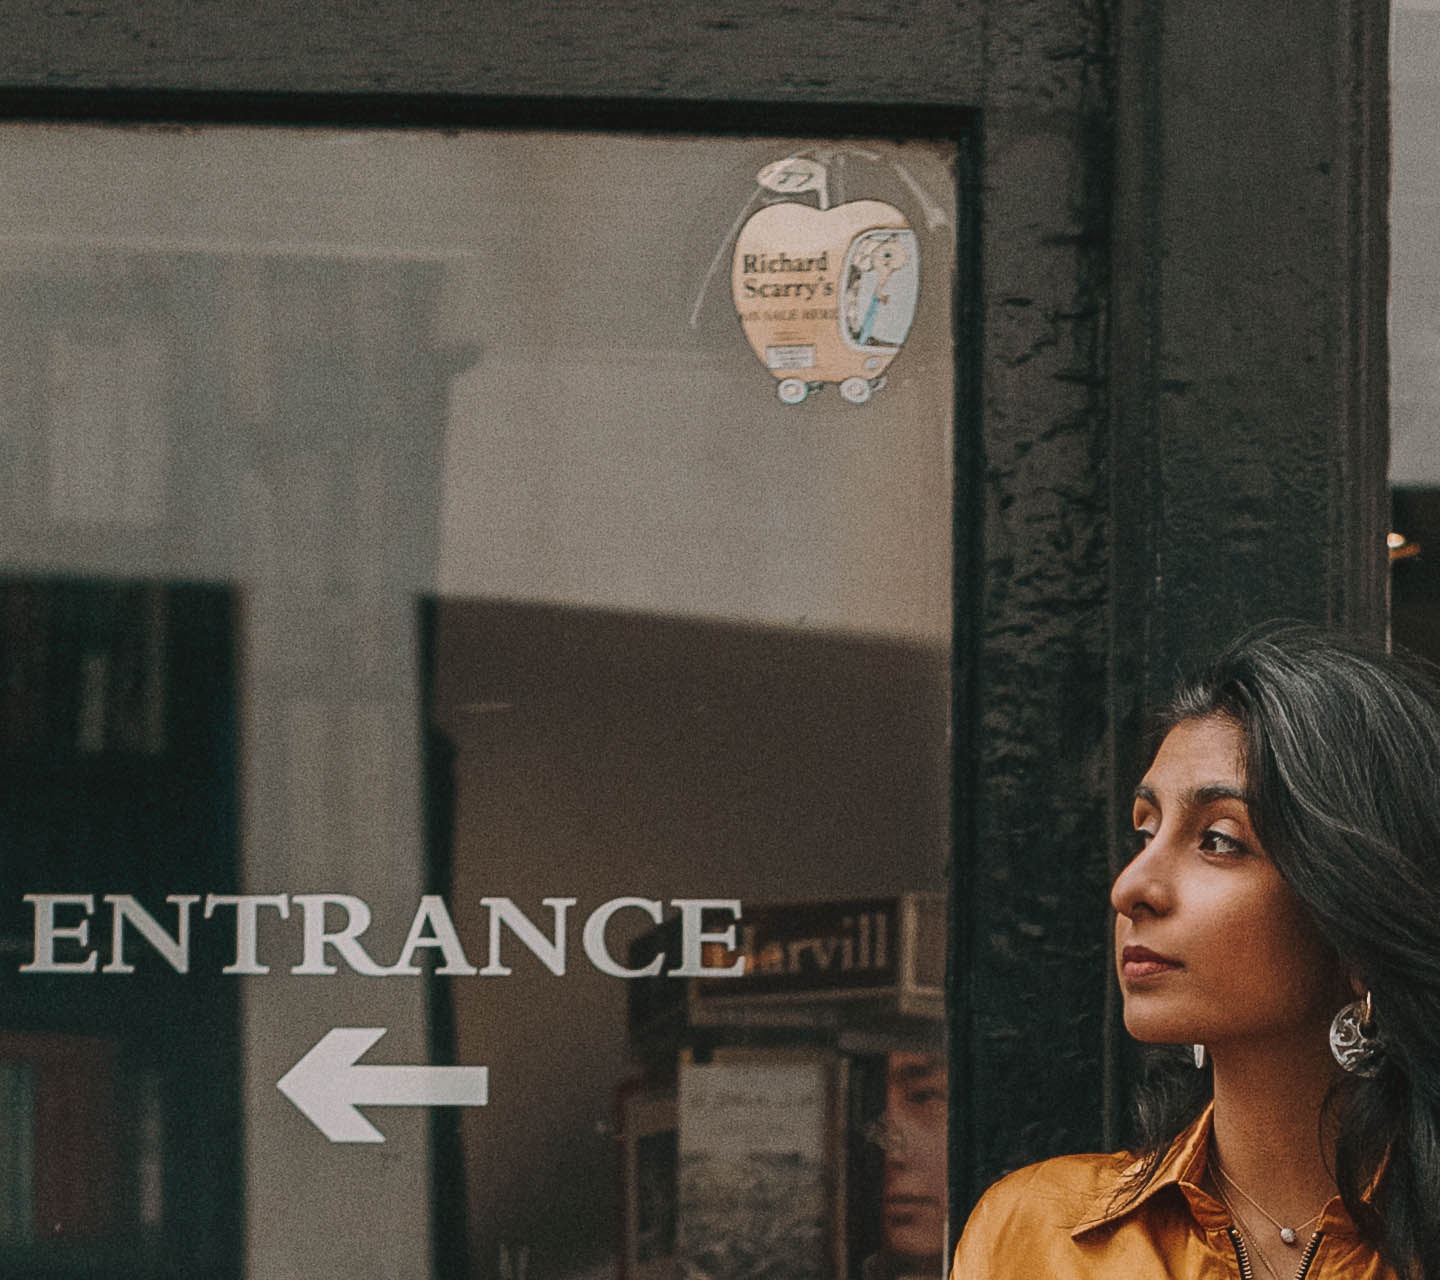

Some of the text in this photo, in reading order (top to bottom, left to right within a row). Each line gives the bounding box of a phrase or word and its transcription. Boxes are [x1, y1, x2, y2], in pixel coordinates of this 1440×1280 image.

[742, 251, 829, 274] Richard
[743, 276, 835, 301] Scarry's
[19, 892, 748, 979] ENTRANCE
